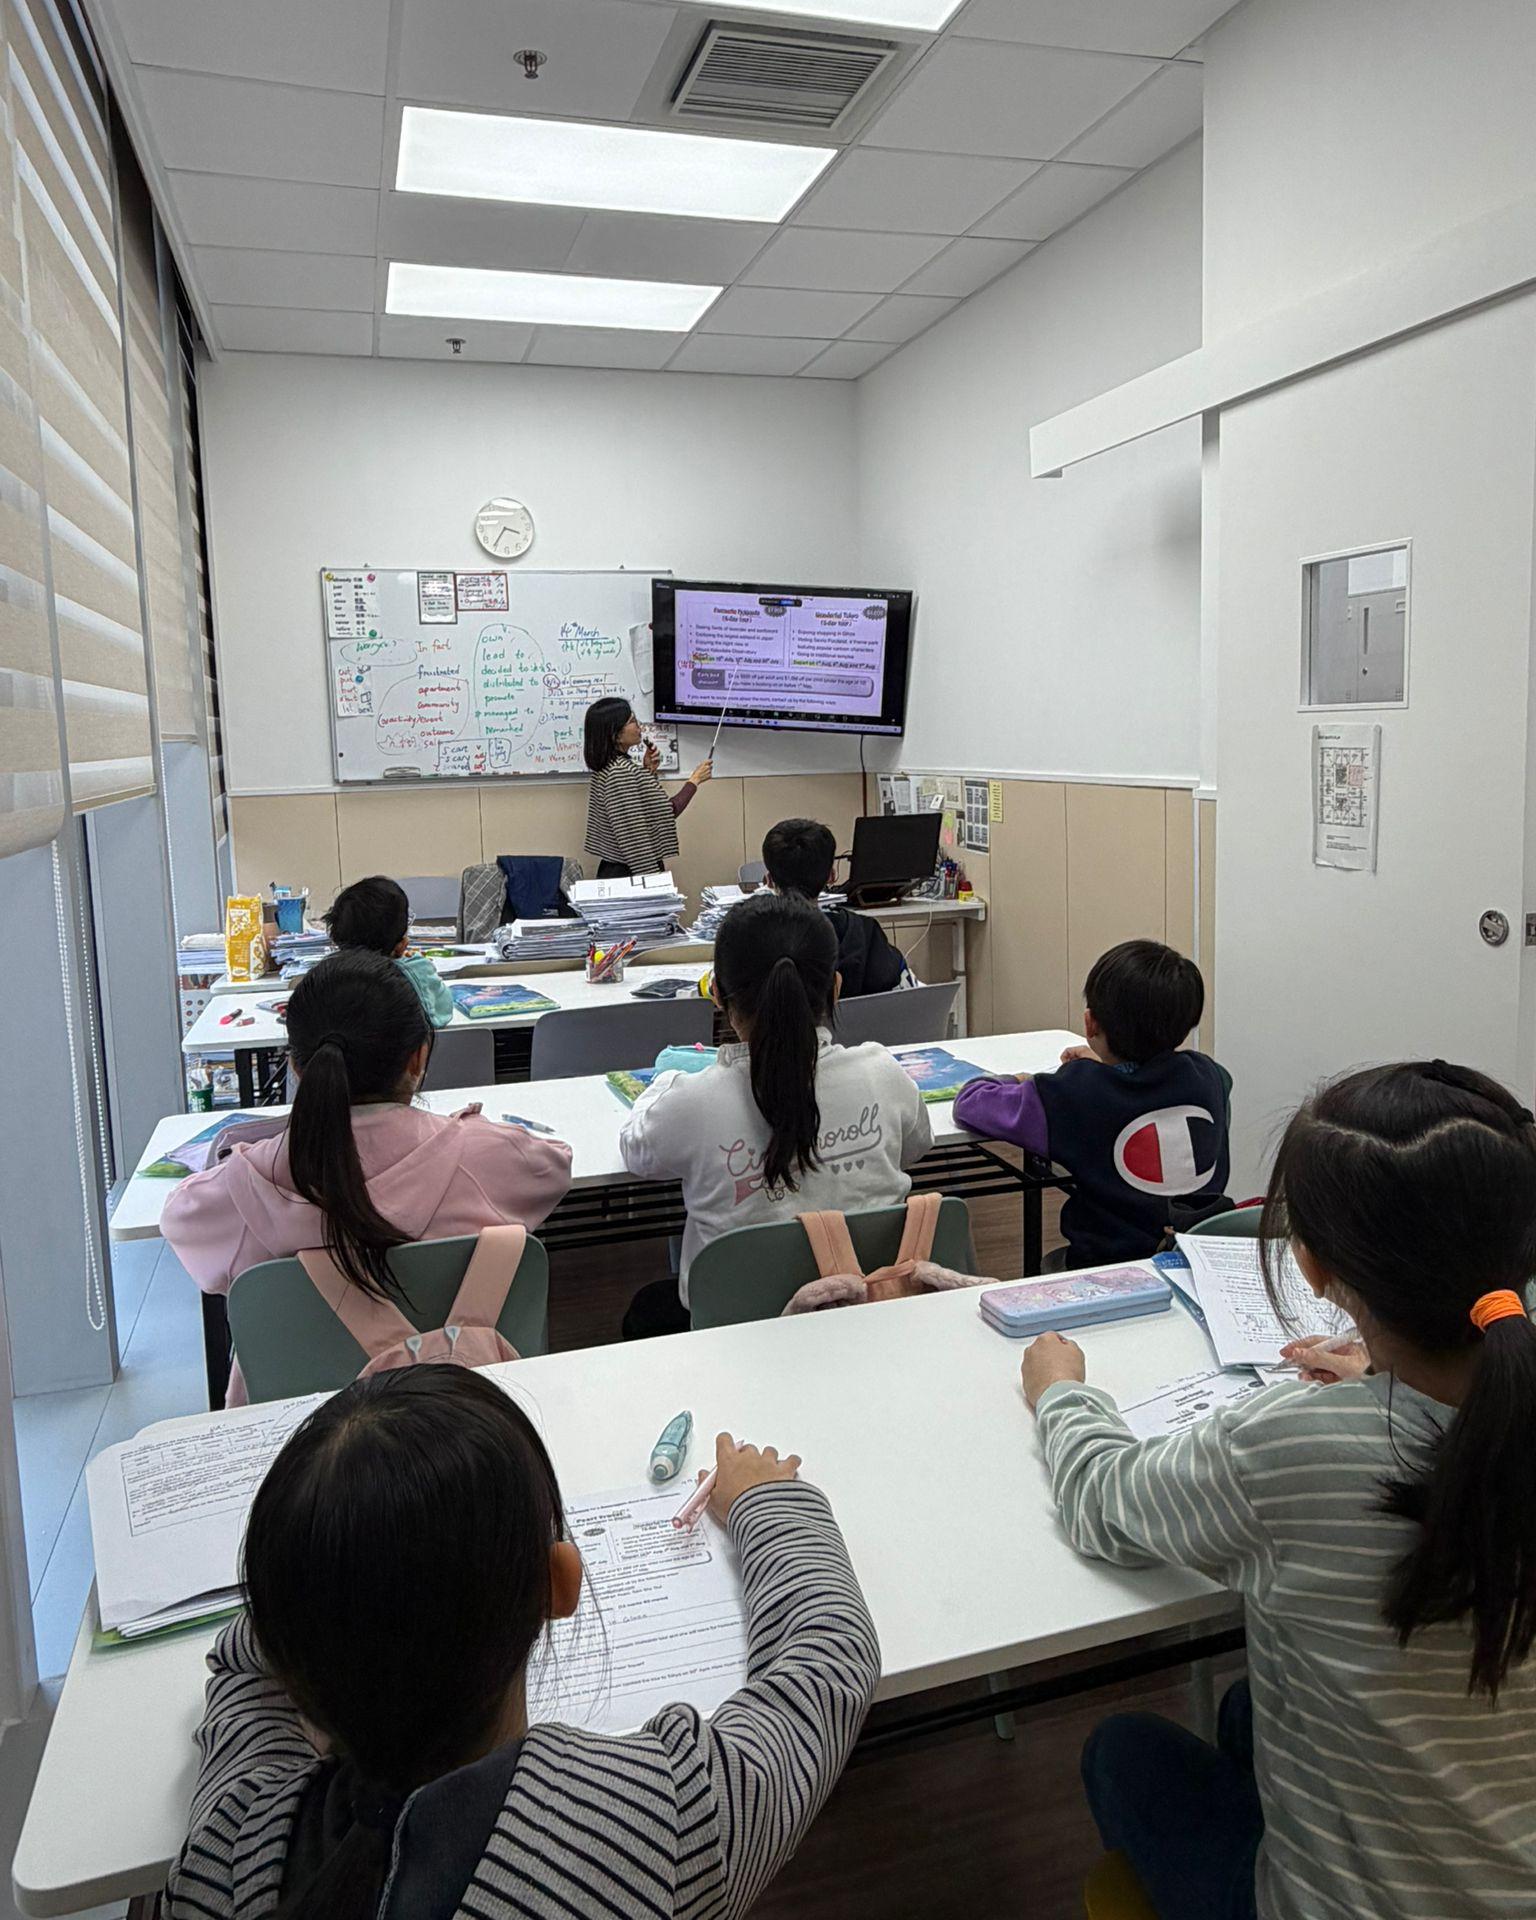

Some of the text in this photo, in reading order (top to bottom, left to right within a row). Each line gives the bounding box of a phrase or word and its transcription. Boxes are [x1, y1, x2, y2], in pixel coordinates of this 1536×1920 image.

[483, 648, 524, 660] lead to
[415, 665, 461, 679] frustrated
[418, 684, 461, 695] apartment
[417, 700, 460, 714] community
